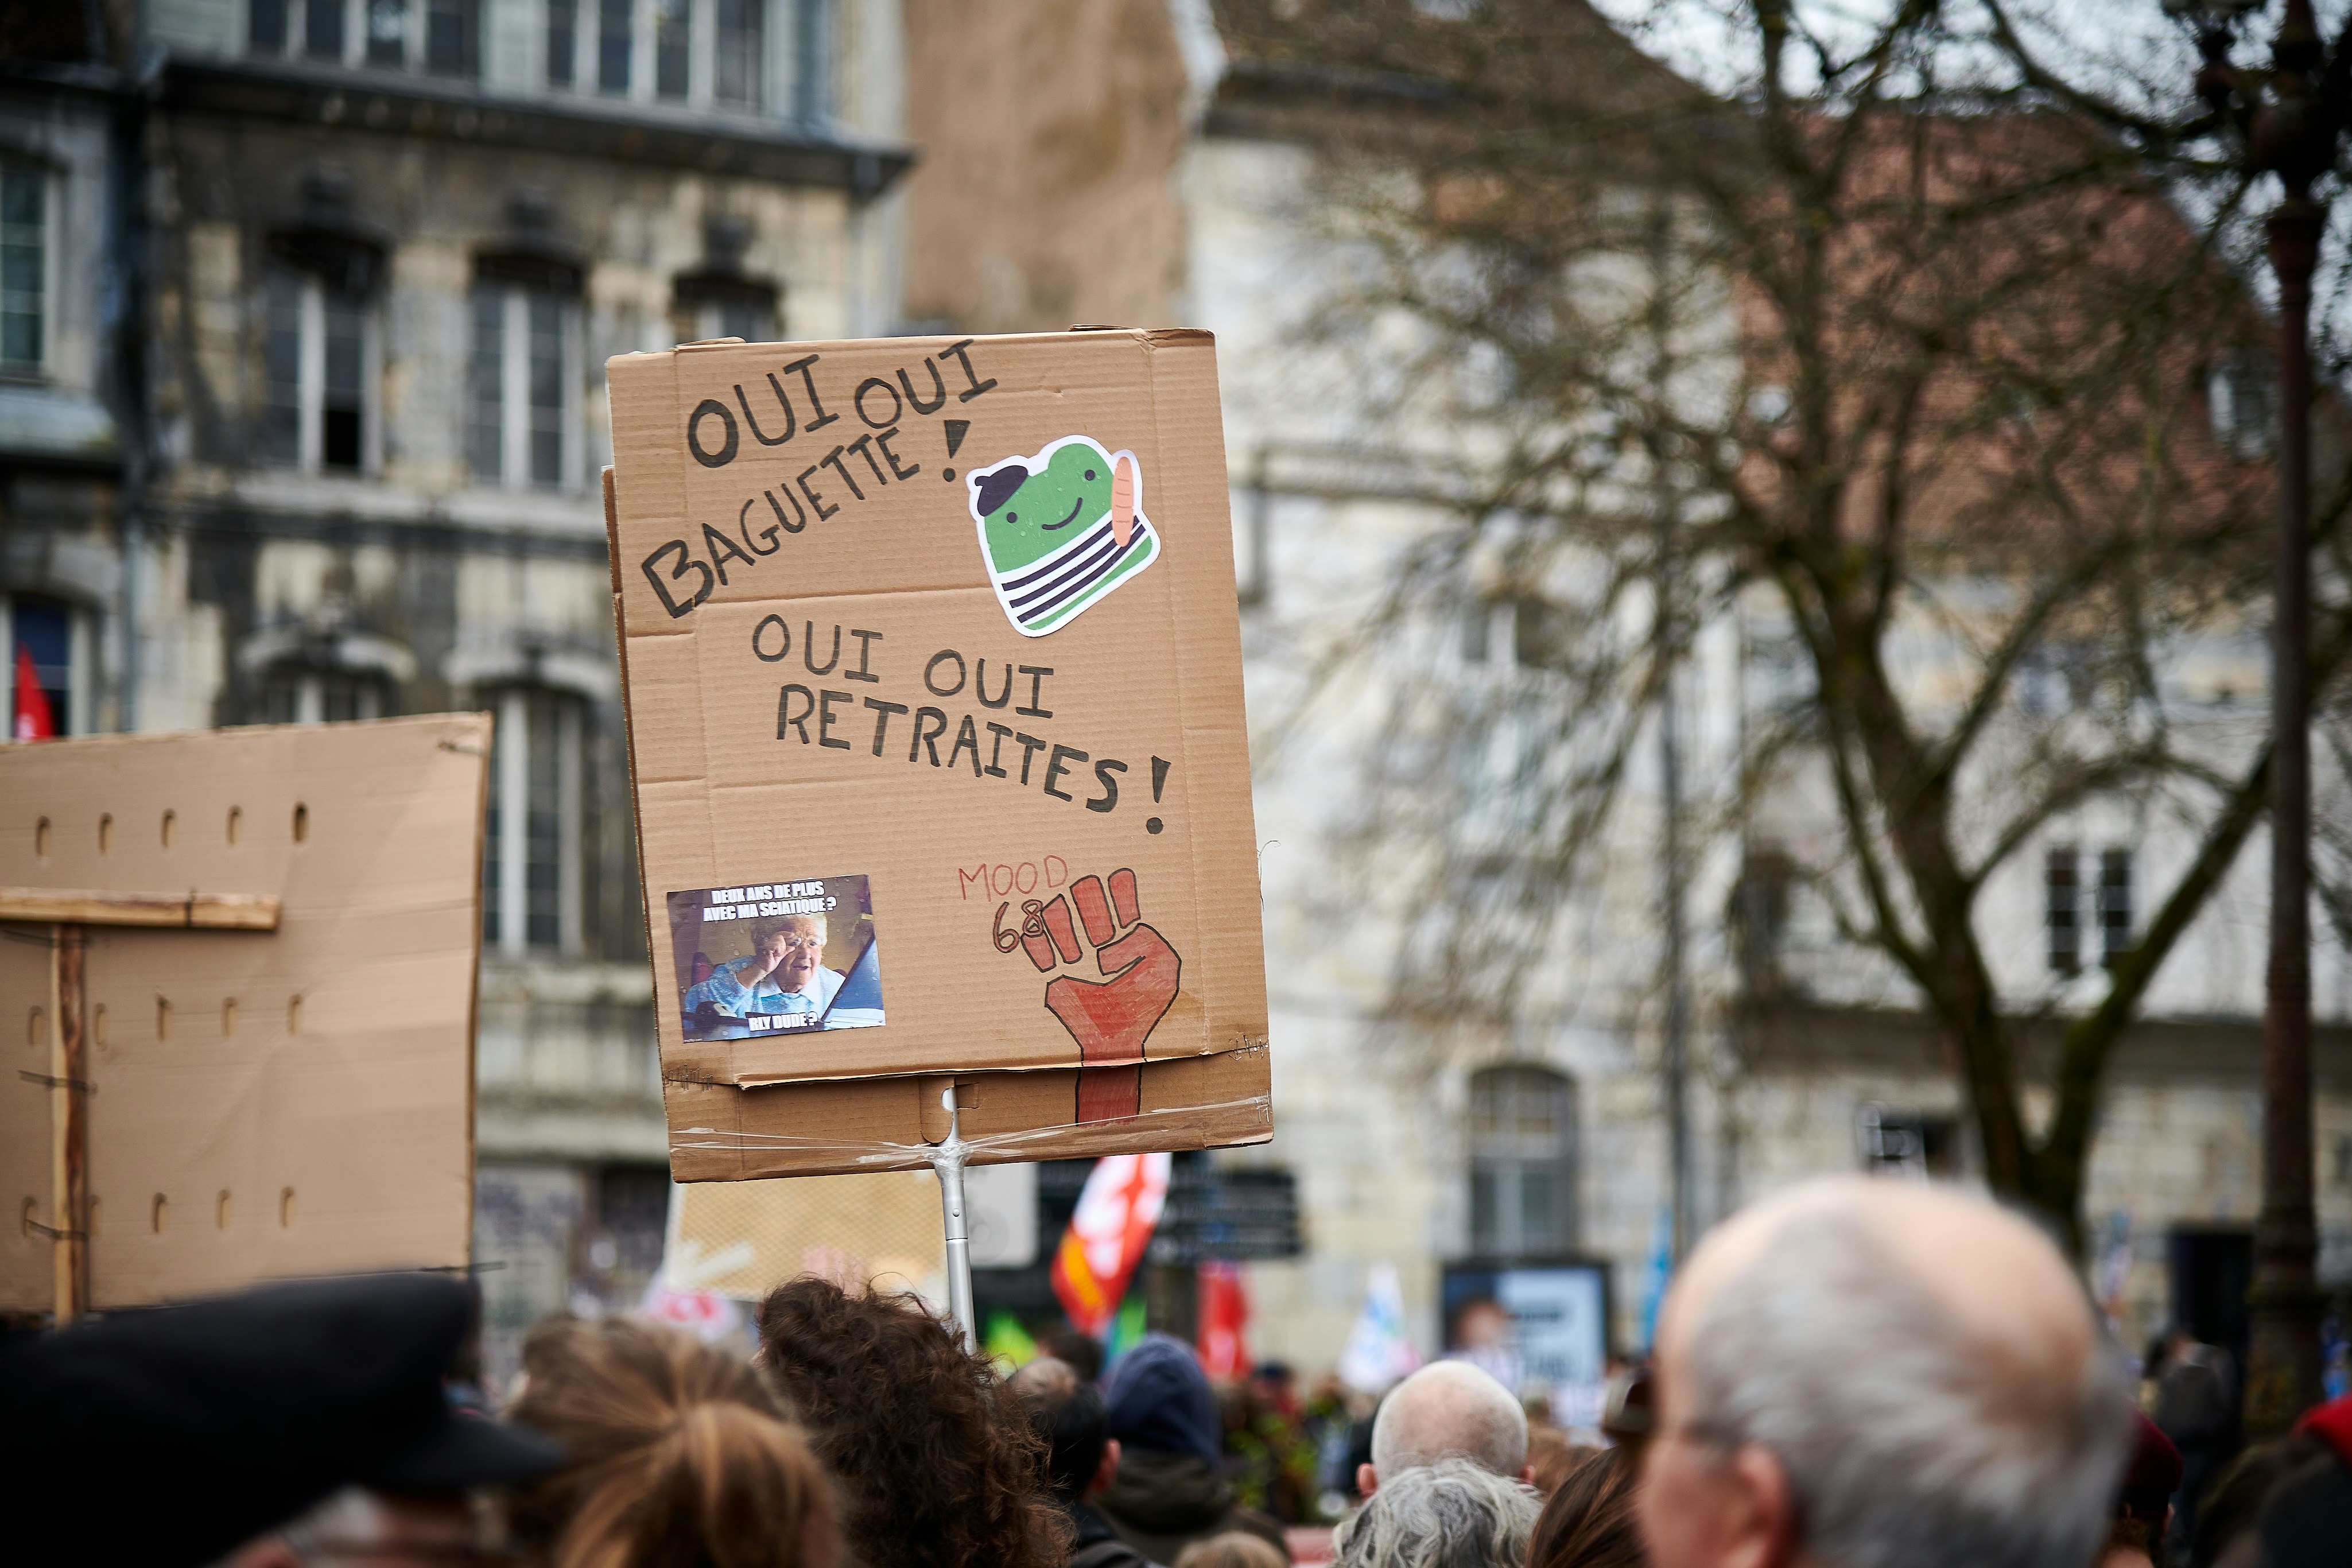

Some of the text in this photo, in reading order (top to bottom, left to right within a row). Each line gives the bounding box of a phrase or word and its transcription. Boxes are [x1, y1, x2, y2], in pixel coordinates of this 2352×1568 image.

[689, 339, 998, 468] OUI OUI
[641, 427, 919, 619] BAGUETTE
[752, 614, 1054, 719] OUI OUI
[776, 684, 1171, 835] RETRAITES !
[711, 880, 825, 905] DEUX ANS DE PLUS
[958, 855, 1069, 902] MOOD
[703, 905, 736, 922] AVEC
[737, 903, 759, 919] MA
[759, 897, 826, 917] SCIATIQUE
[993, 899, 1043, 953] 68
[748, 1016, 771, 1031] RLY
[772, 1012, 808, 1029] DUDE
